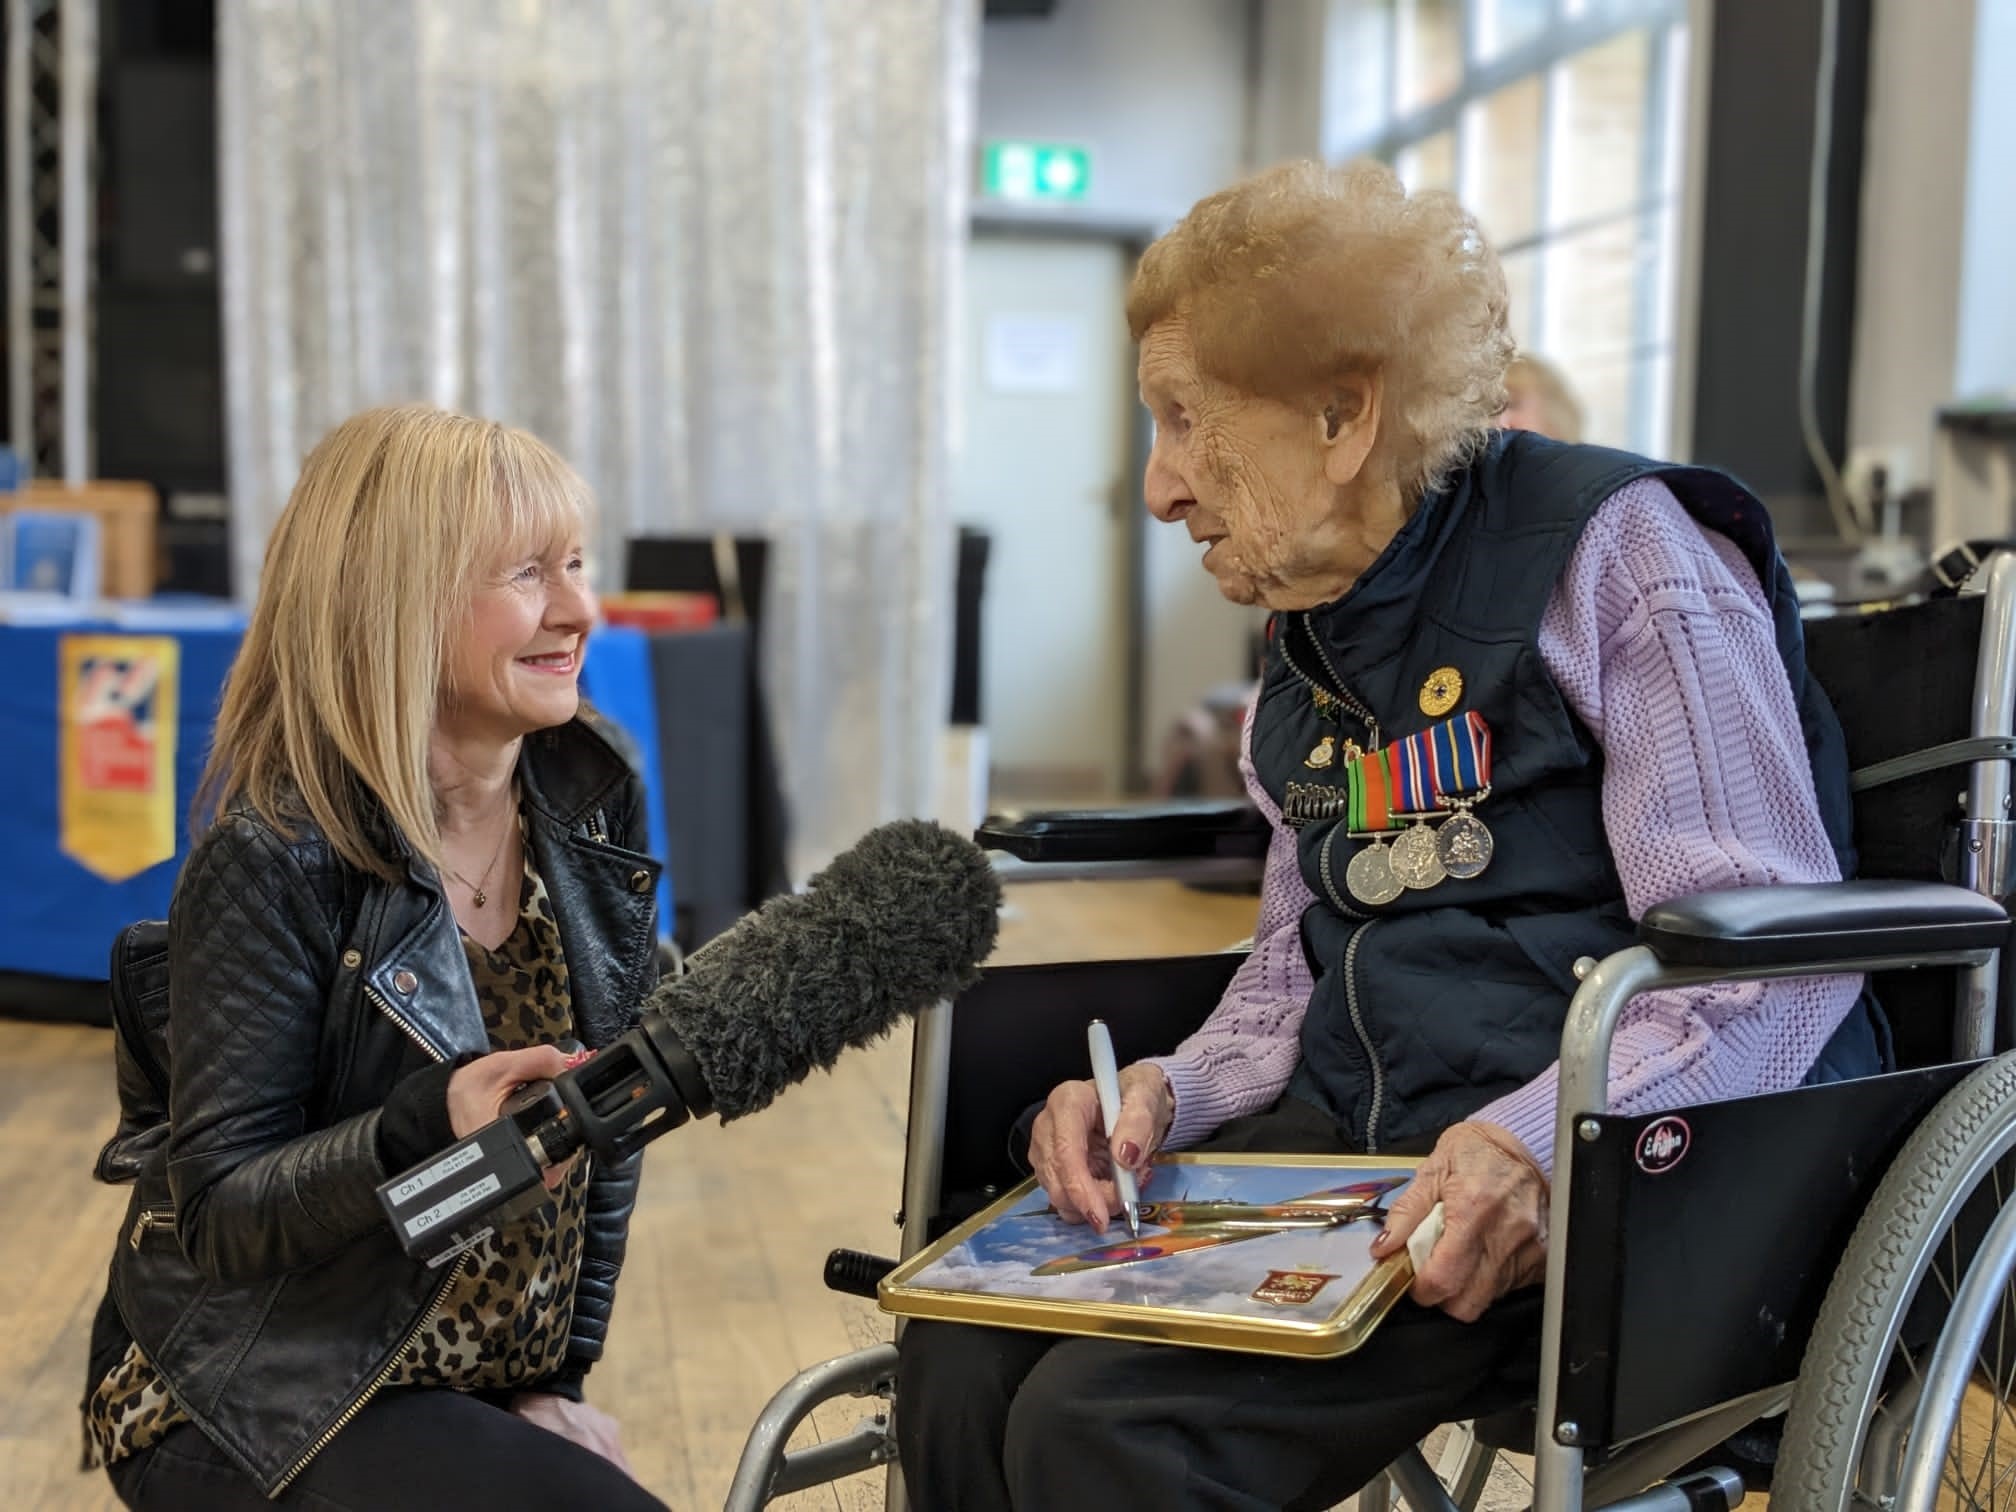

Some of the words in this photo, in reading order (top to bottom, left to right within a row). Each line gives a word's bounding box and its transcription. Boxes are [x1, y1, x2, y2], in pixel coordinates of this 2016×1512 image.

[400, 1183, 416, 1196] Ch
[417, 1178, 424, 1187] 1
[416, 1215, 433, 1227] Ch
[433, 1208, 441, 1219] 2
